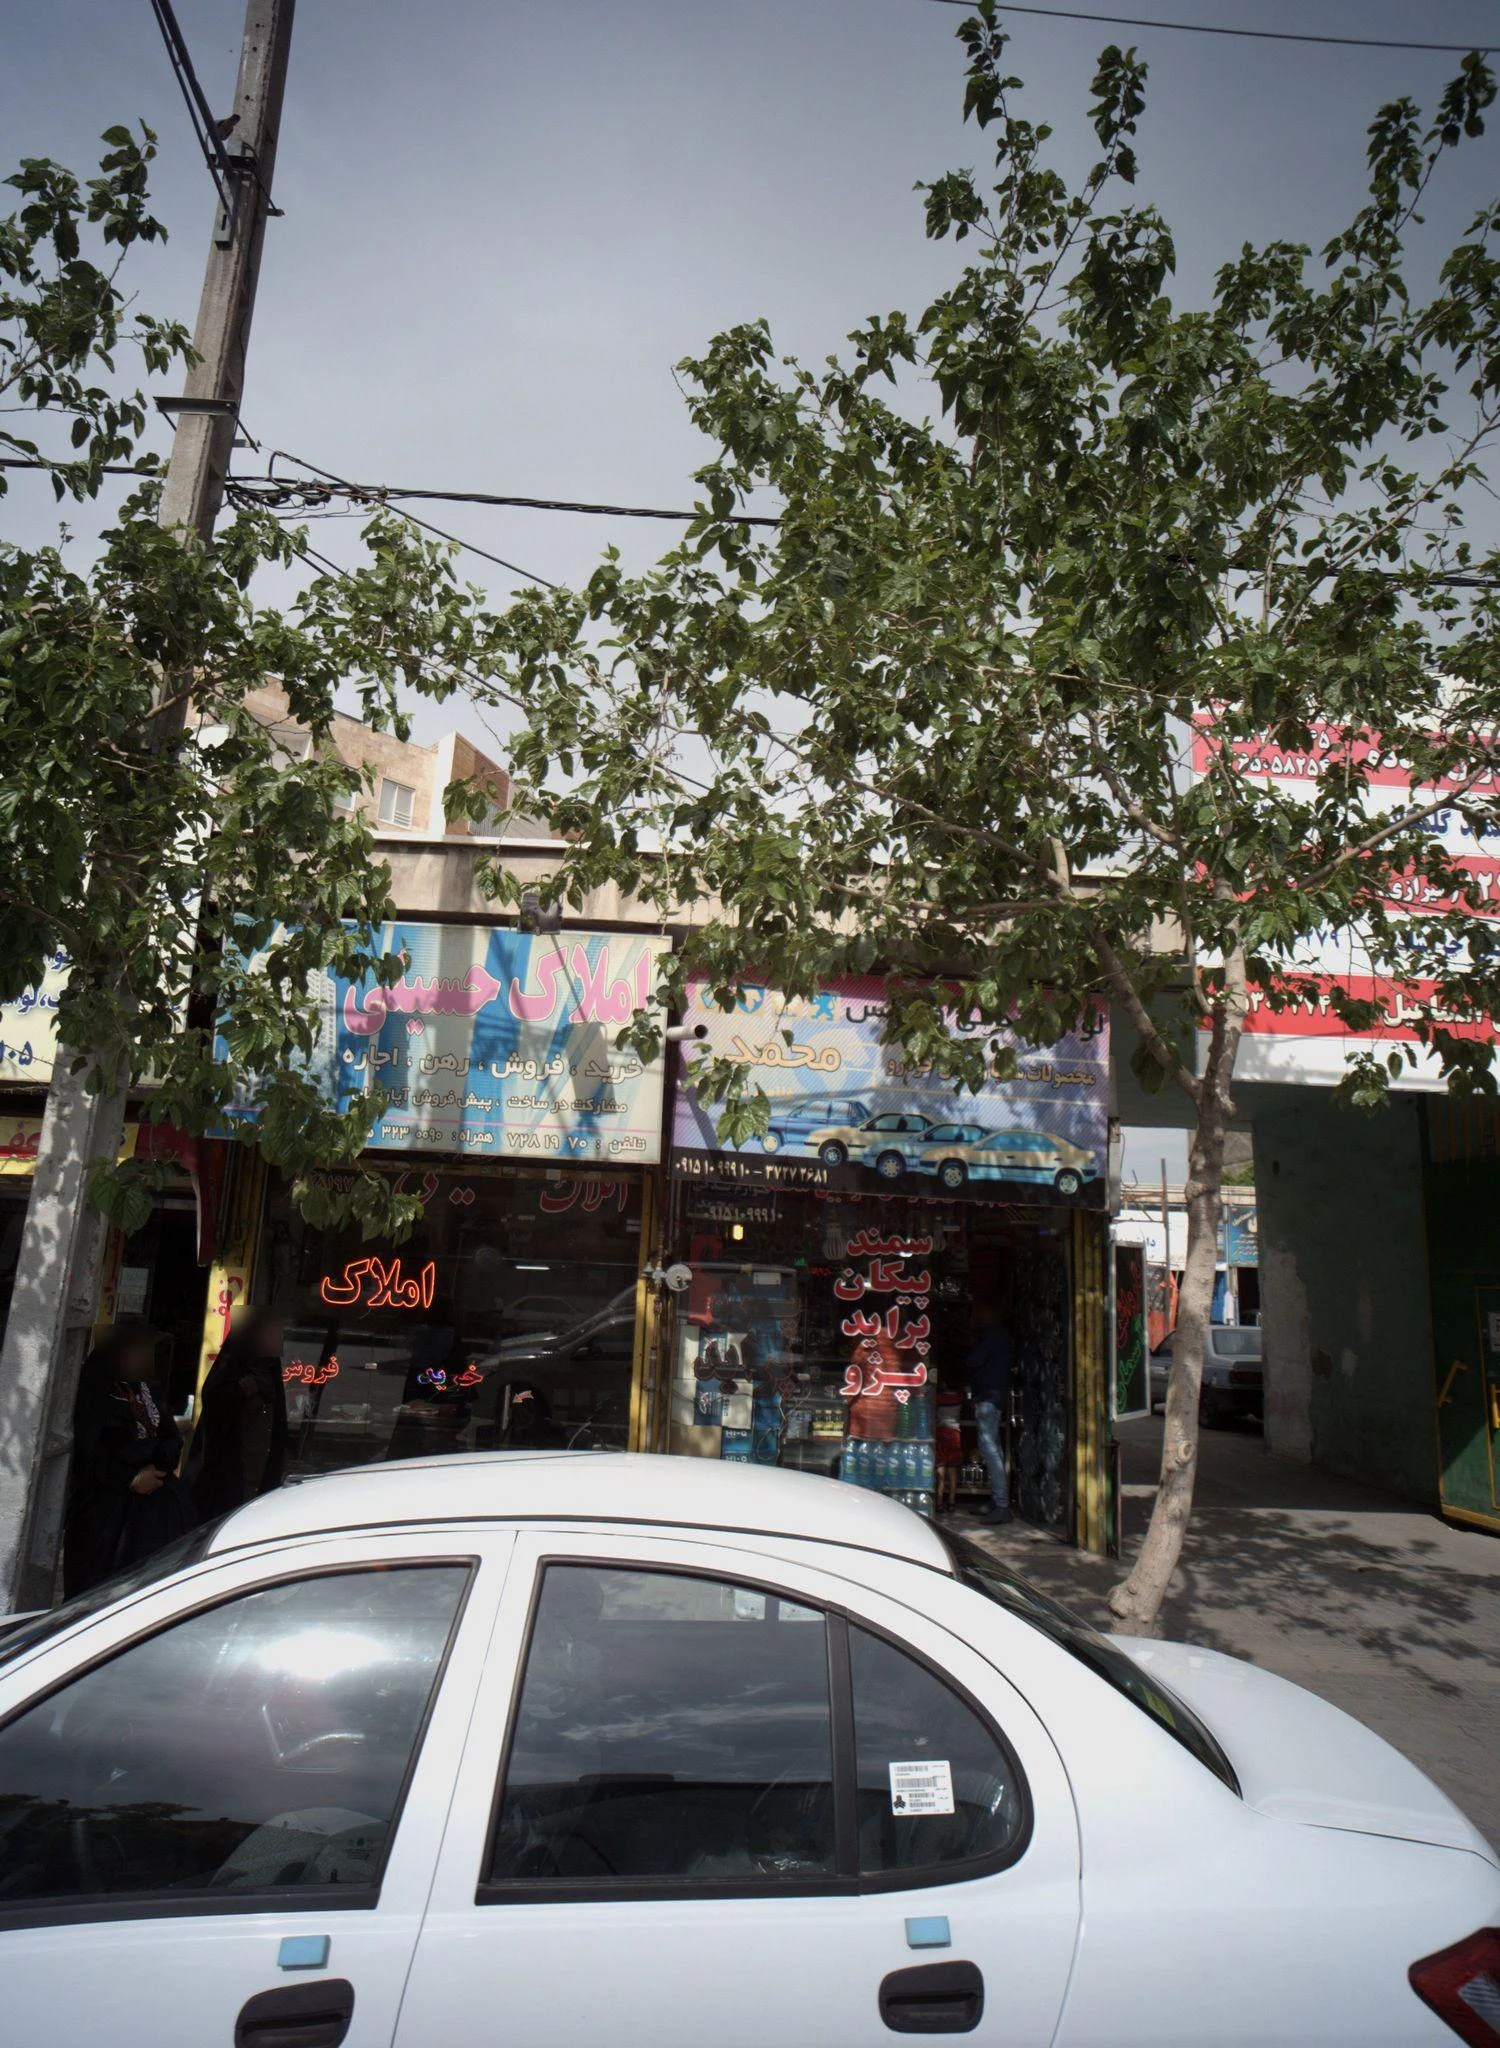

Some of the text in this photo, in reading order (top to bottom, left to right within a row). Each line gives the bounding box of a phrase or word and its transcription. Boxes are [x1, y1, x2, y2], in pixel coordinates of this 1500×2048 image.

[343, 943, 651, 1036] املاک حسینی
[342, 1044, 643, 1084] خرید فروش رهن اجاره
[712, 1034, 841, 1073] محمد
[1025, 1063, 1097, 1089] محصولات
[412, 1088, 457, 1108] فروش
[457, 1091, 493, 1112] پیش
[507, 1094, 549, 1110] ساخت
[551, 1098, 569, 1114] در
[571, 1100, 628, 1115] مشارکت
[846, 1227, 933, 1257] سمند
[321, 1256, 436, 1309] املاک
[833, 1258, 932, 1310] پیکان
[841, 1305, 932, 1355] پراید
[417, 1362, 485, 1391] خرید
[839, 1351, 928, 1403] پژو
